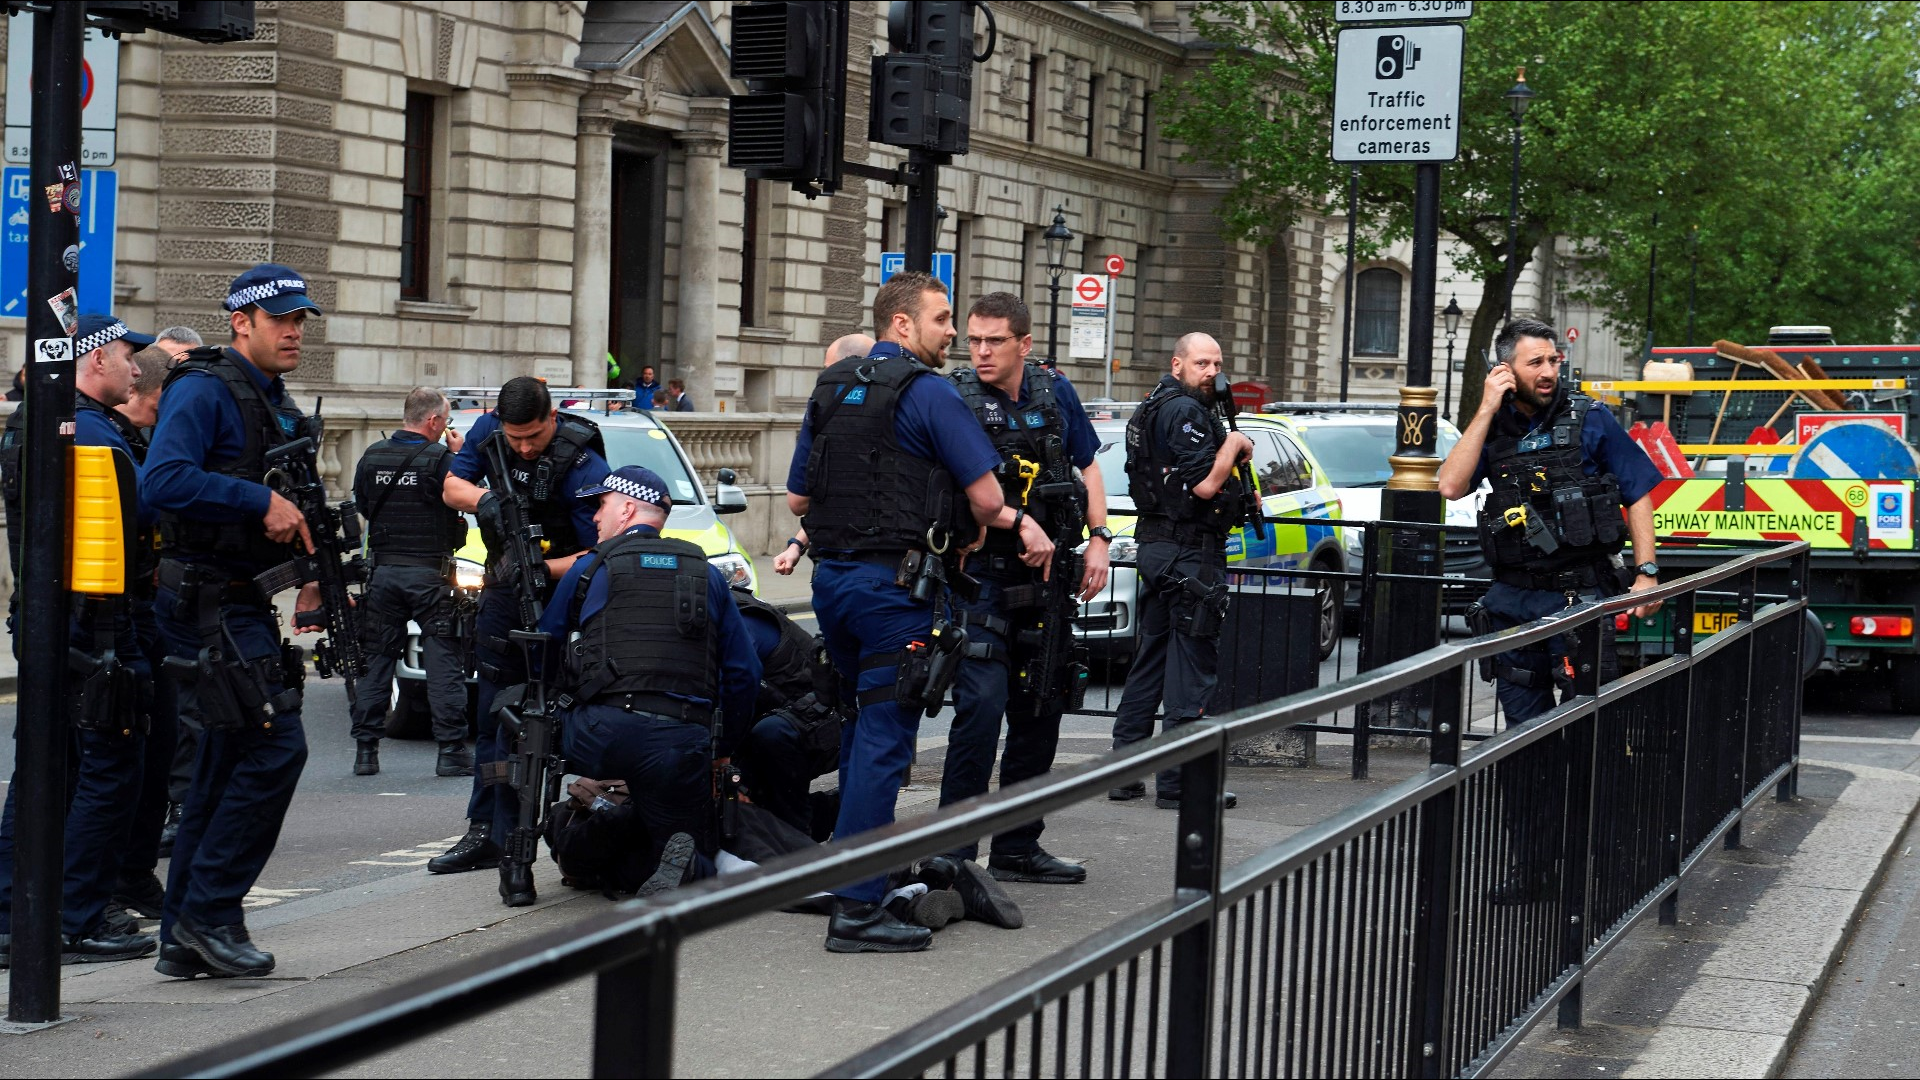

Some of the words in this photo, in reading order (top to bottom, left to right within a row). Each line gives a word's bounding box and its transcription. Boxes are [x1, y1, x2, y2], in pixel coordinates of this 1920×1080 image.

[1341, 1, 1374, 13] 8.30
[1377, 2, 1397, 12] am
[1409, 1, 1441, 11] 6.30
[1445, 1, 1466, 12] pm
[1368, 91, 1425, 107] Traffic
[1340, 114, 1451, 131] enforcement
[1358, 141, 1430, 154] cameras
[9, 231, 28, 243] tax
[1107, 258, 1120, 273] C
[276, 279, 306, 289] POLICE
[1567, 328, 1577, 339] A
[375, 475, 418, 485] POICE
[1849, 490, 1864, 501] 68
[1653, 513, 1710, 530] GHWAY
[1715, 513, 1835, 531] MAINTENANCE
[643, 556, 674, 566] POLICE
